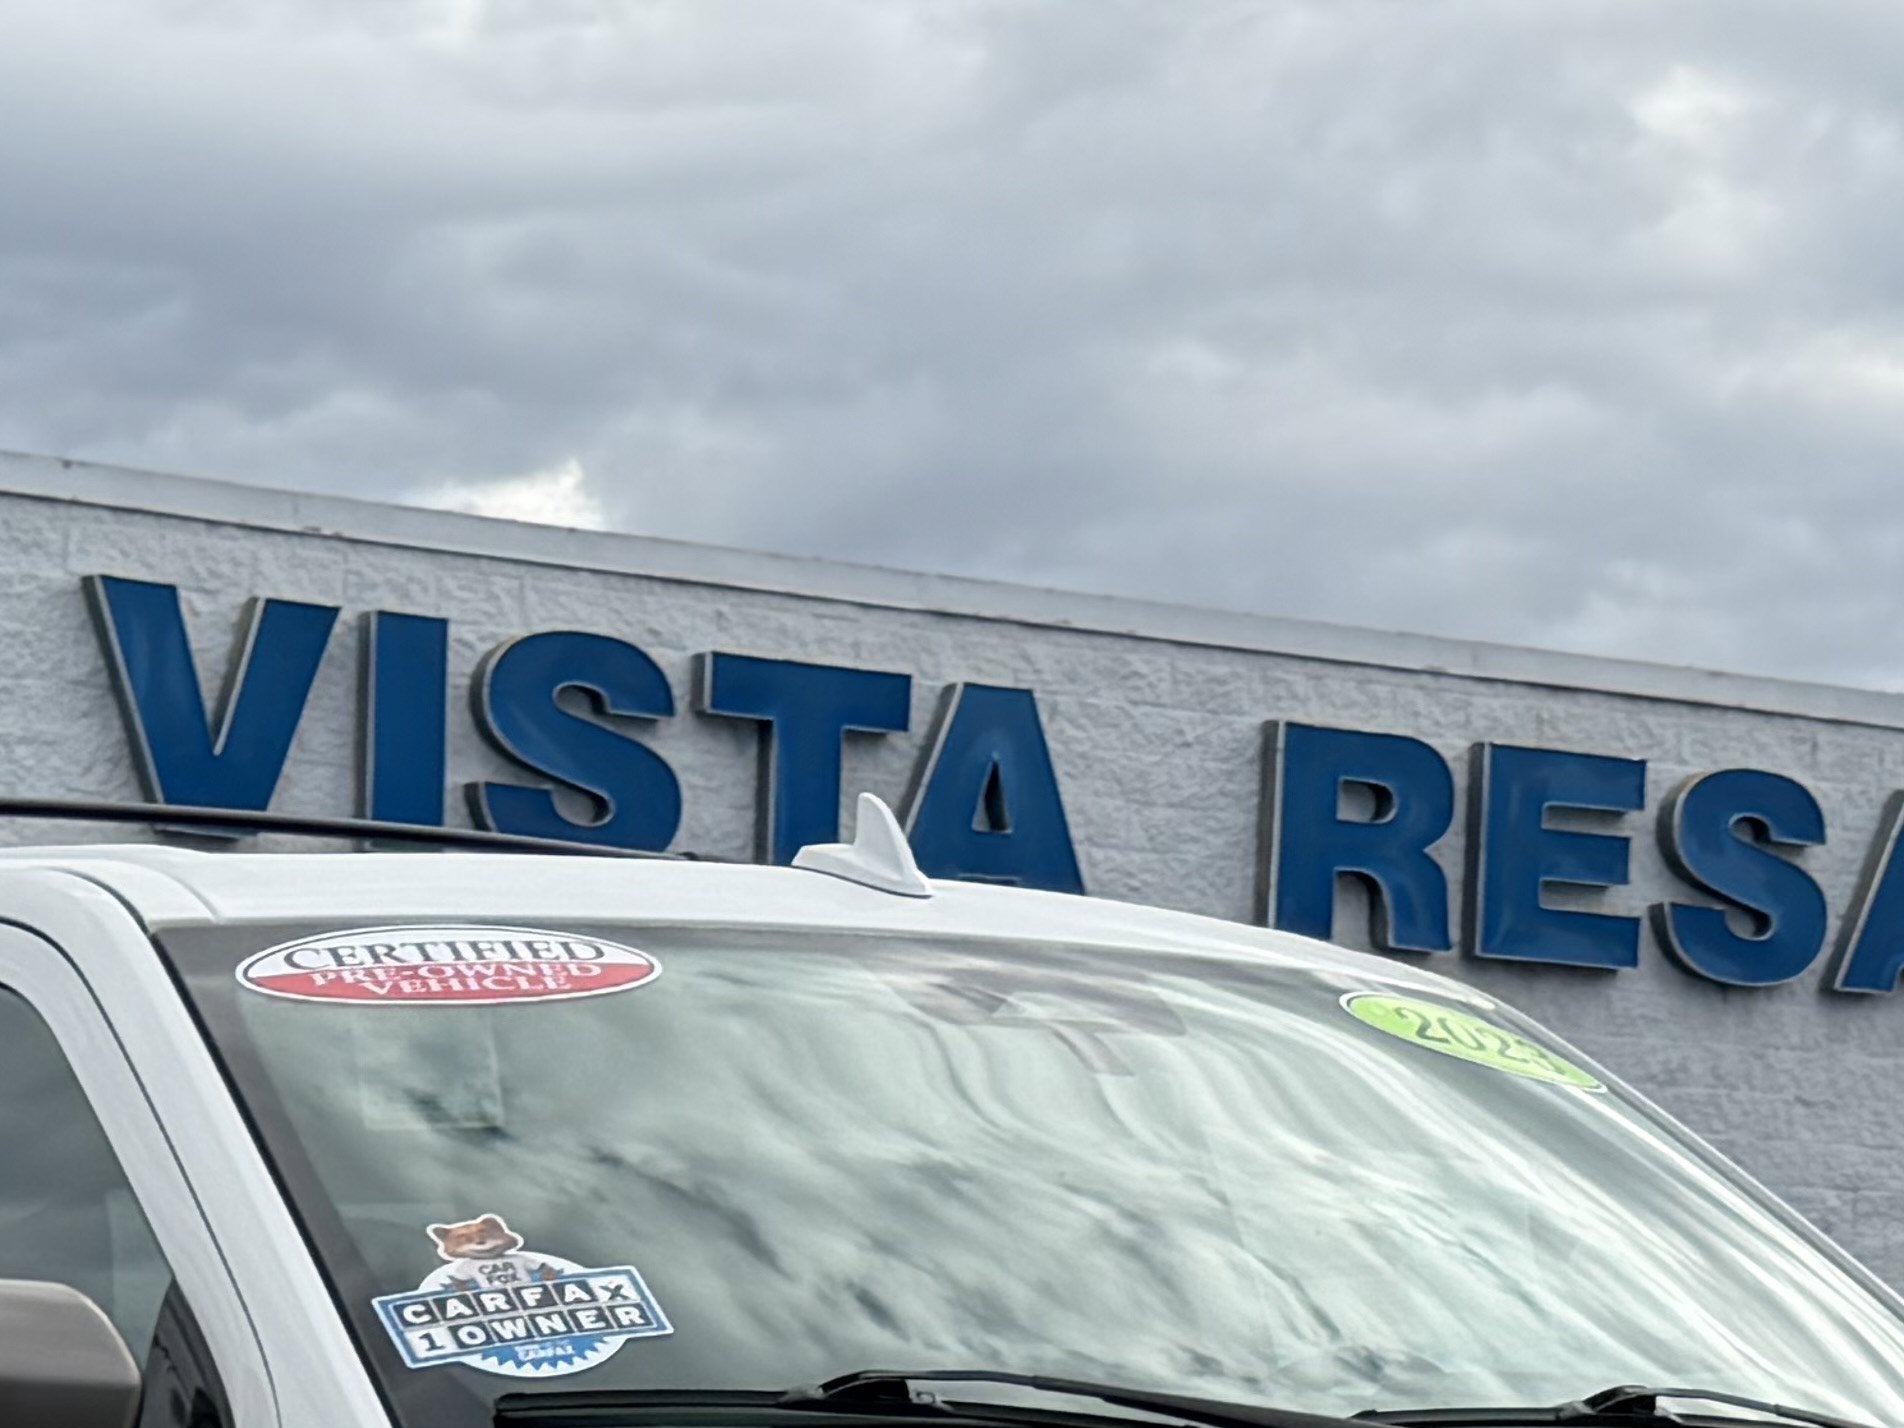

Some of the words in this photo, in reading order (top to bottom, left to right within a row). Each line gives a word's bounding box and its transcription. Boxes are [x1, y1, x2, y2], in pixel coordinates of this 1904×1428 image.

[84, 573, 1085, 894] VISTA
[283, 940, 605, 970] CERTIFIED
[308, 961, 602, 986] PRE-OWNED
[358, 976, 573, 995] VEHICLE
[402, 1283, 630, 1324] CARFAX
